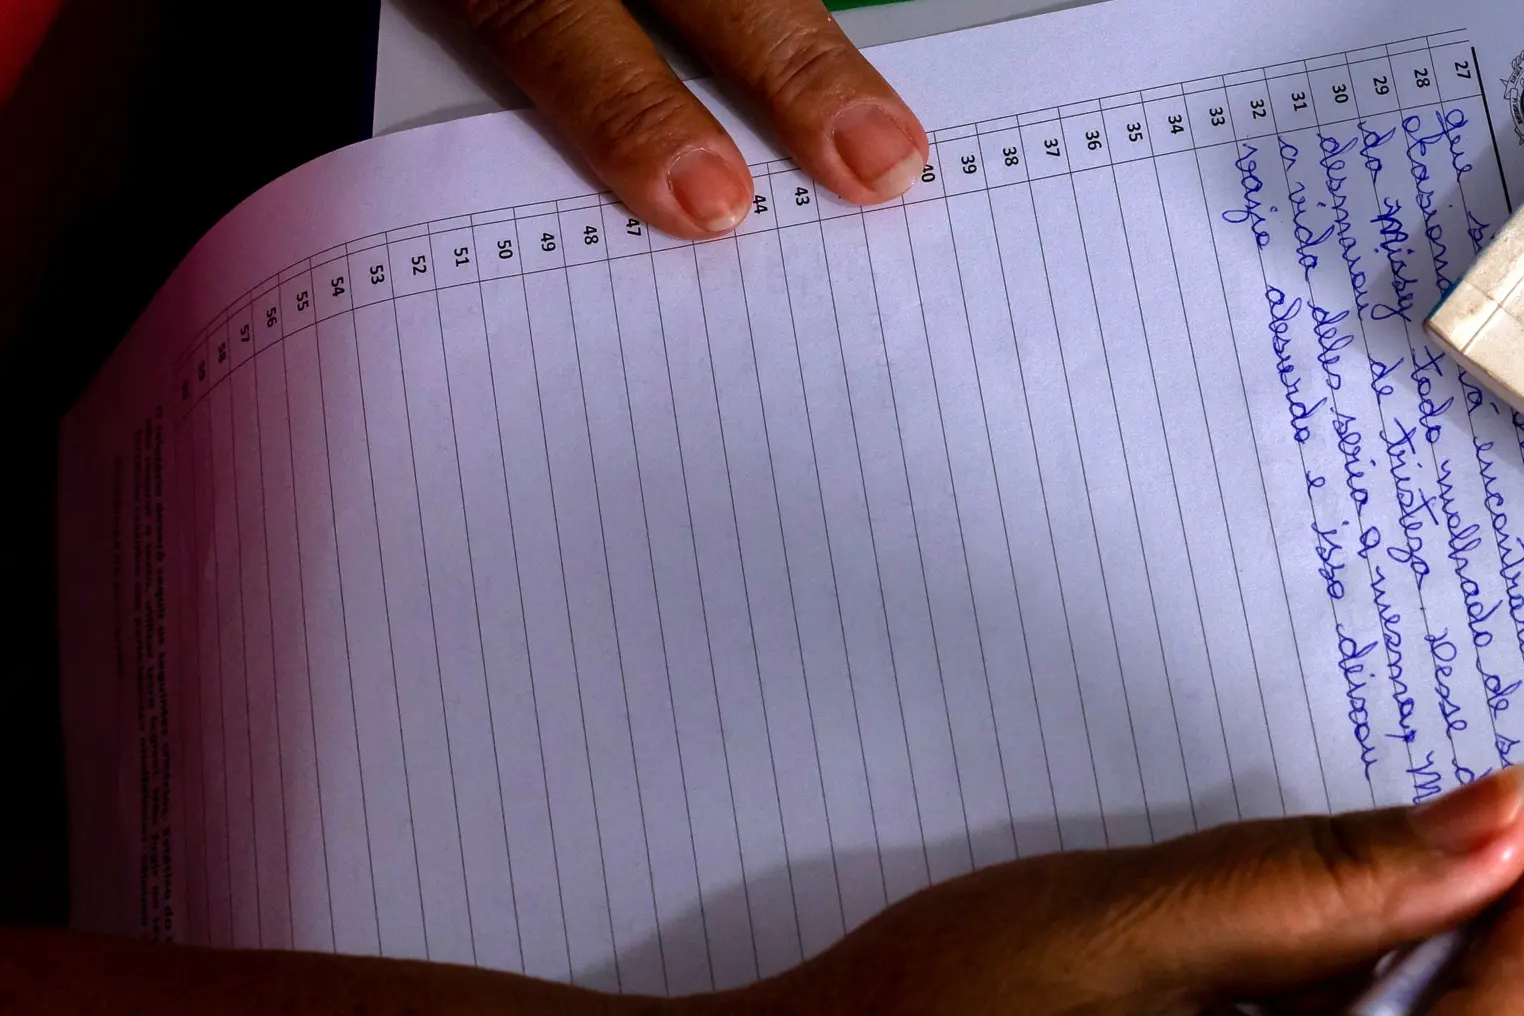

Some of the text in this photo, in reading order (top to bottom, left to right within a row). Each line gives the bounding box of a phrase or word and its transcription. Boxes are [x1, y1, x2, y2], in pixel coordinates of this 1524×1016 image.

[1413, 67, 1431, 89] 28
[1454, 60, 1472, 79] 27
[1332, 83, 1349, 104] 30
[1372, 75, 1390, 96] 29
[1250, 99, 1267, 120] 32
[1291, 91, 1308, 112] 31
[1167, 114, 1185, 135] 34
[1208, 106, 1226, 127] 33
[1085, 130, 1103, 151] 36
[1126, 122, 1144, 143] 35
[1002, 146, 1020, 167] 38
[1043, 138, 1061, 157] 37
[960, 154, 978, 175] 39
[752, 194, 769, 215] 44
[794, 186, 811, 207] 43
[625, 212, 643, 237] 47
[540, 232, 557, 252] 49
[583, 225, 599, 246] 48
[453, 247, 470, 268] 51
[496, 239, 514, 260] 50
[369, 264, 385, 285] 53
[411, 255, 427, 276] 52
[330, 276, 346, 297] 54
[296, 290, 310, 312] 55
[266, 306, 278, 328] 56
